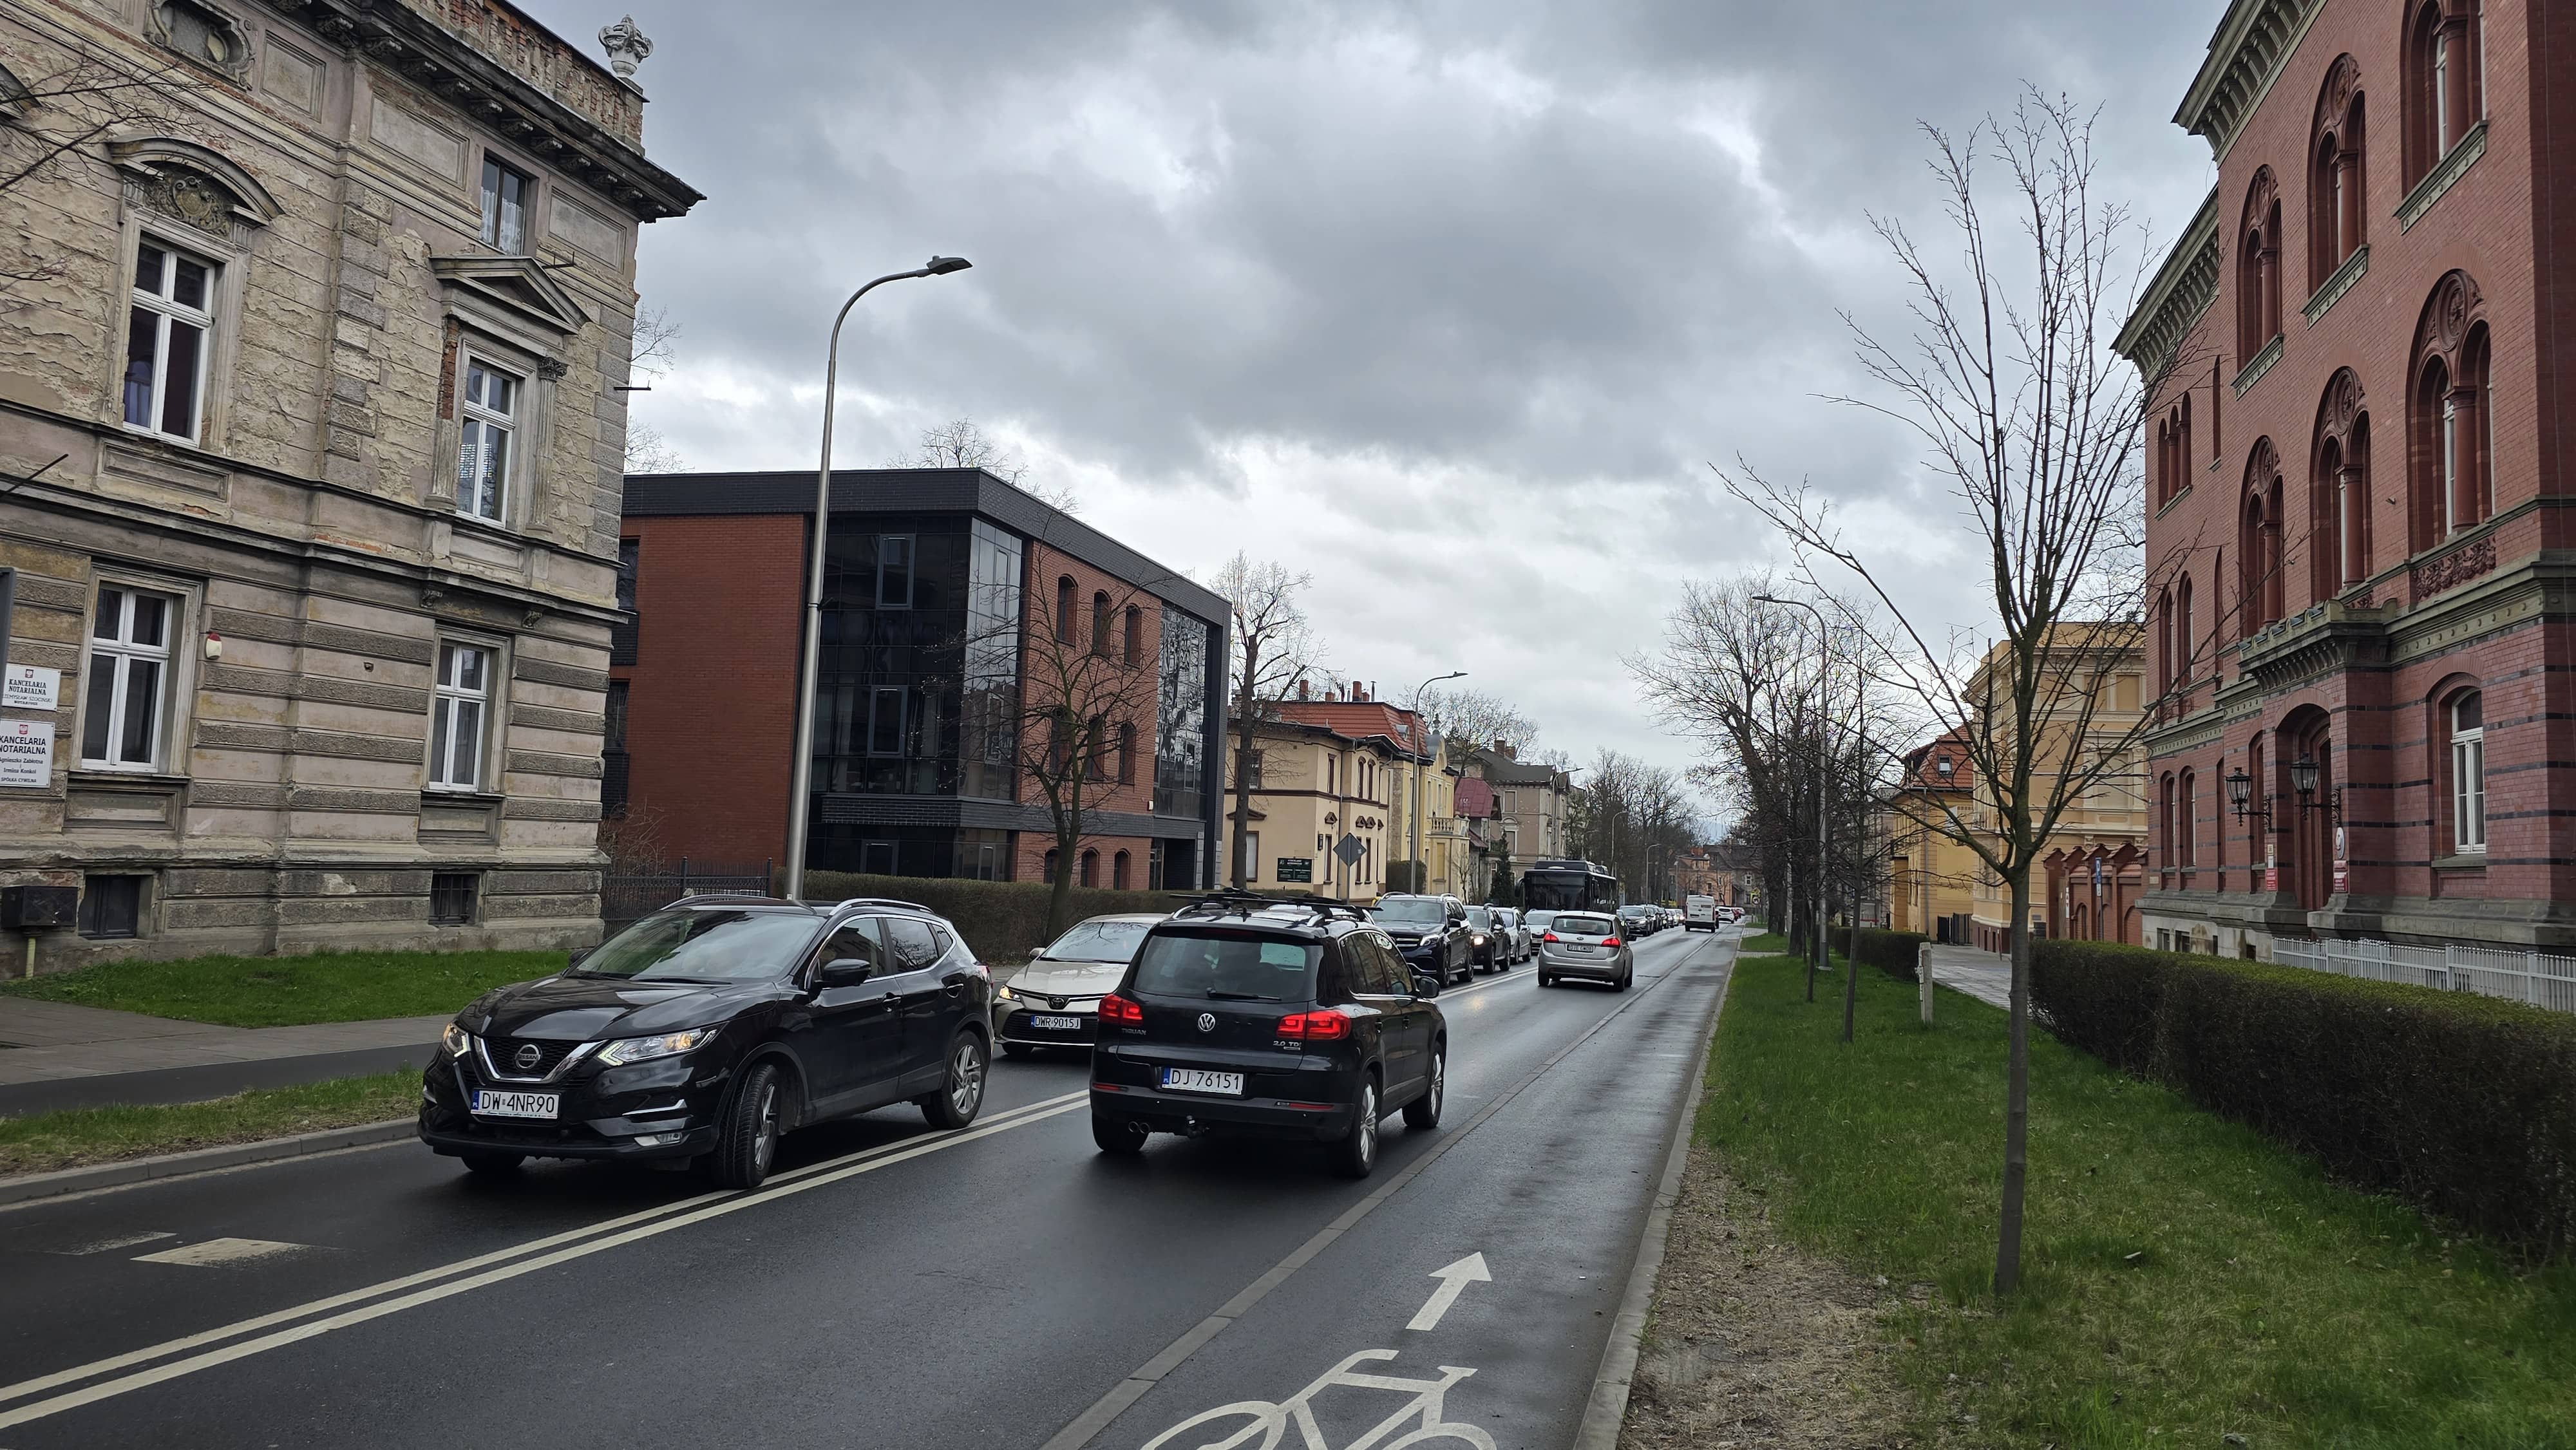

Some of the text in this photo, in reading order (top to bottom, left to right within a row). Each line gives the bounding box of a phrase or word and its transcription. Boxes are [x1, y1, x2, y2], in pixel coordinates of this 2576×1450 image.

[9, 679, 46, 688] KANCELARIA
[8, 686, 46, 695] NOTARIALNA
[0, 735, 46, 746] KANCELARIA
[1035, 1017, 1079, 1028] DWR 9015J
[1171, 1070, 1190, 1085] DJ
[1196, 1071, 1239, 1089] 76151
[482, 1092, 554, 1113] DW 4NR90
